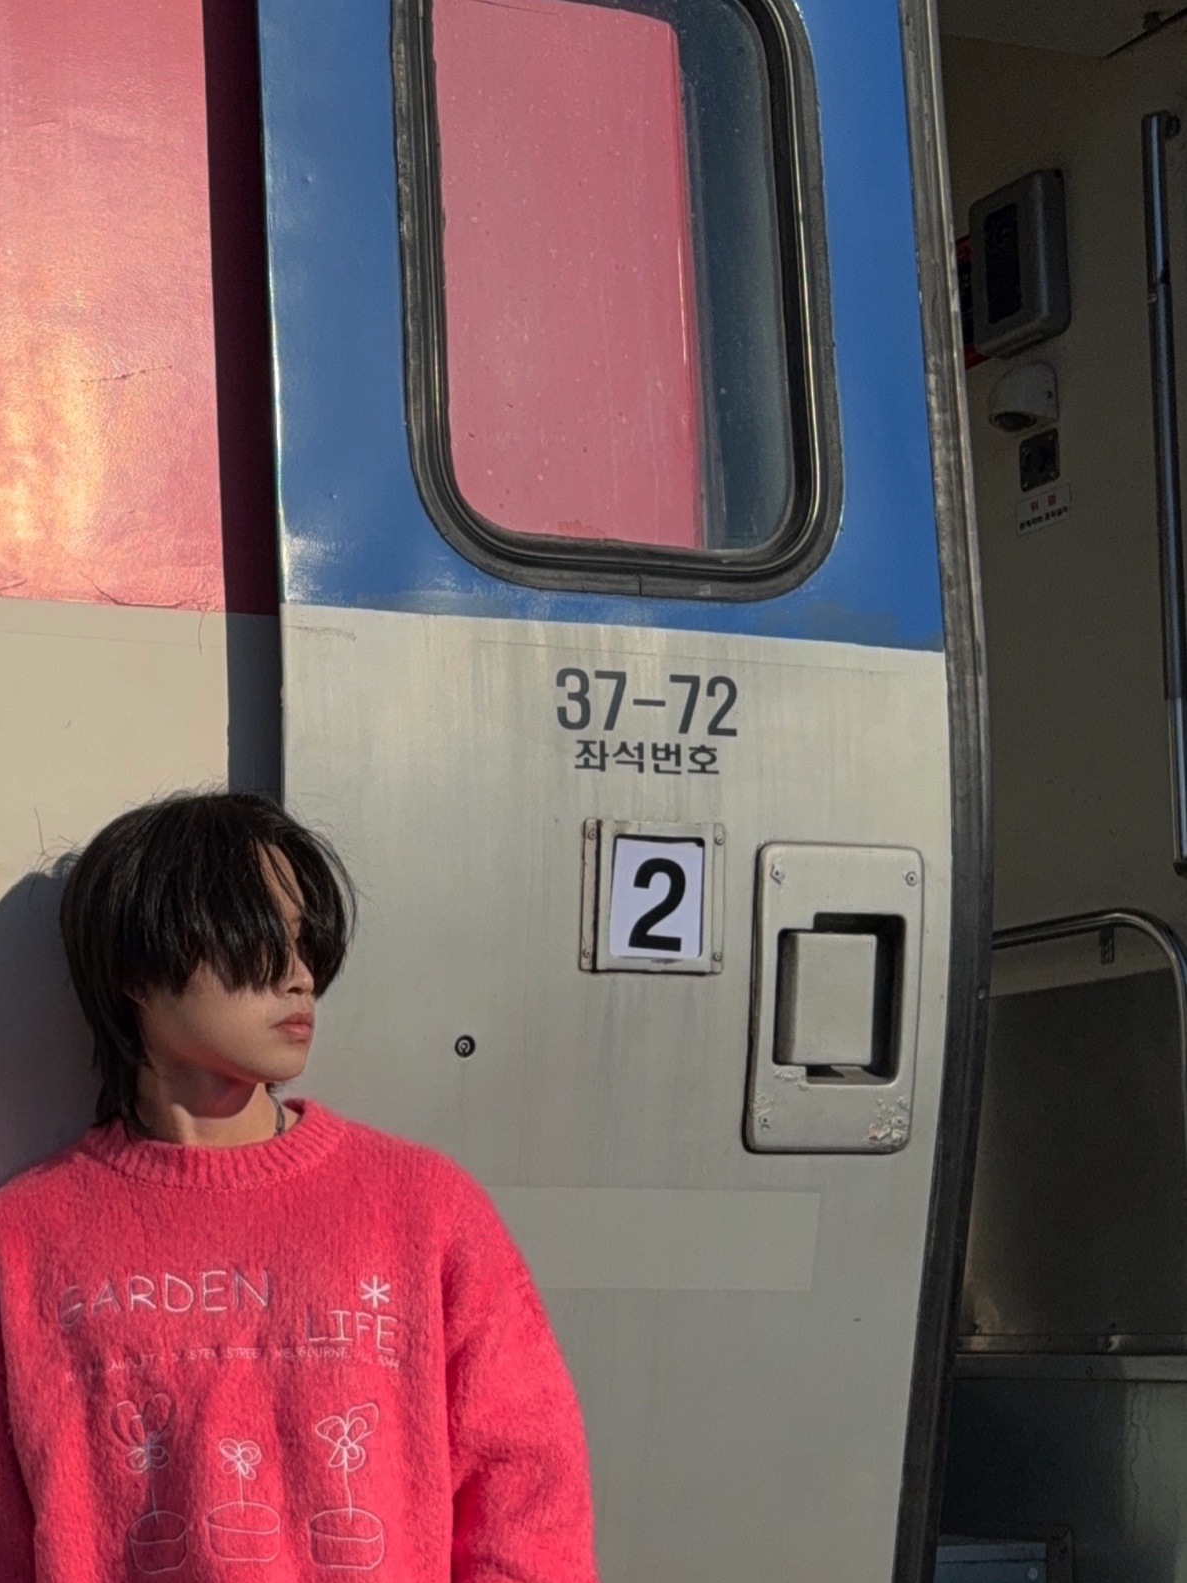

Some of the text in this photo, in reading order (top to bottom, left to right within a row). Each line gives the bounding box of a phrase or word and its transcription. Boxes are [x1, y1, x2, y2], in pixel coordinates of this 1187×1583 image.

[555, 667, 738, 737] 37-72
[573, 739, 721, 776] 좌석번호
[627, 856, 687, 953] 2
[307, 1304, 398, 1353] LIFE
